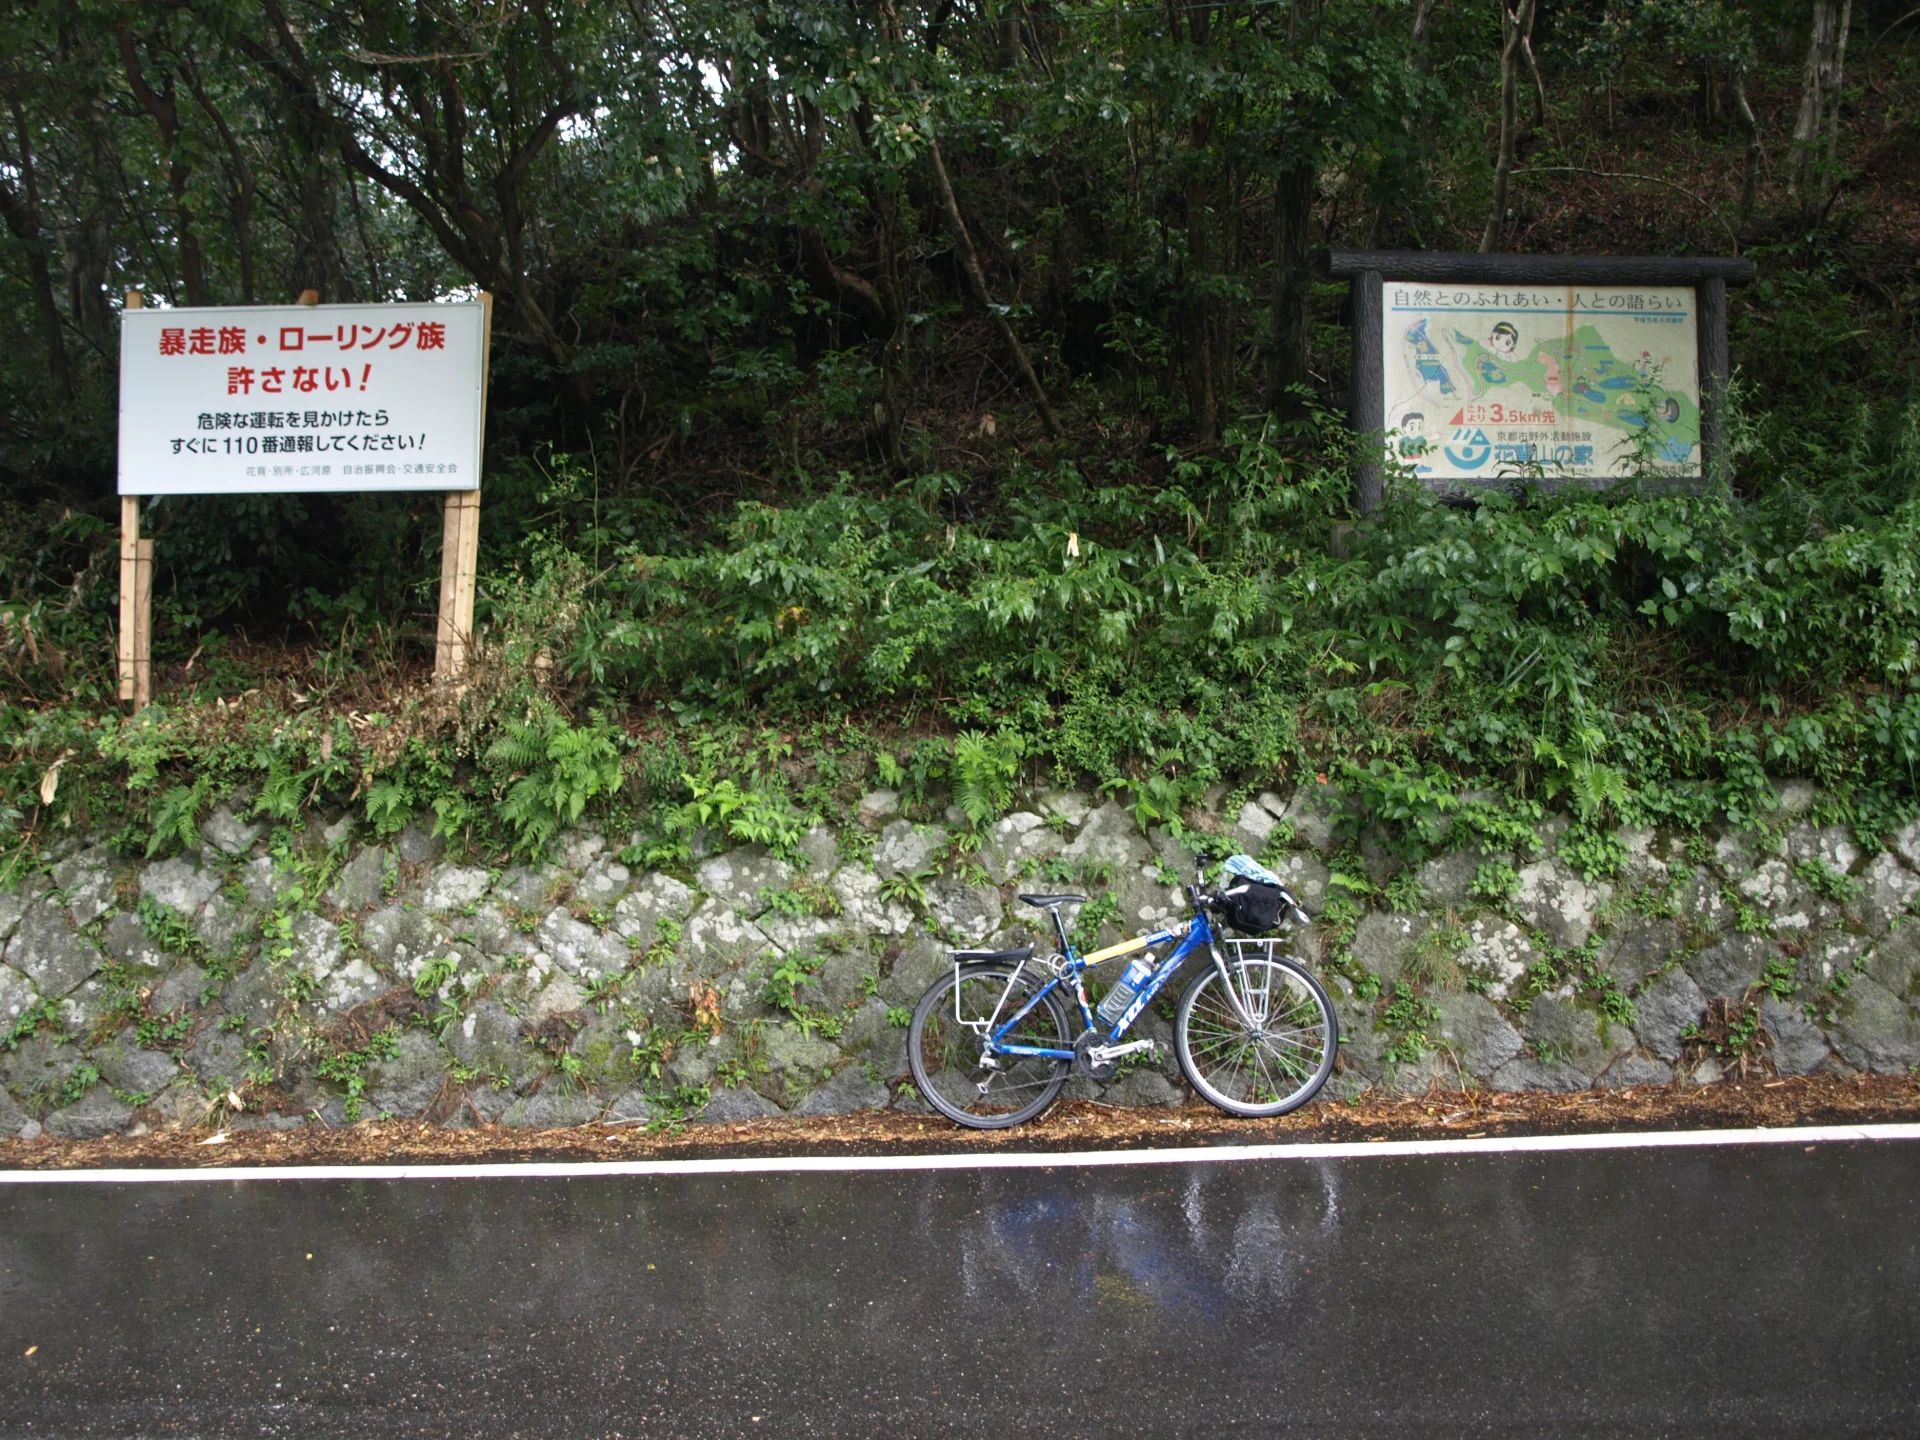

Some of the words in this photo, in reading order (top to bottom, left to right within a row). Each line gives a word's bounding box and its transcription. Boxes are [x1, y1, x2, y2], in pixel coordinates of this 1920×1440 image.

[1393, 288, 1682, 310] 自然とのふれあい・人との語らい
[159, 321, 446, 356] 暴走族・ローリング族
[227, 363, 373, 395] 許さない！
[1467, 404, 1486, 413] これ
[1467, 413, 1486, 423] より
[1489, 402, 1556, 424] 3.5km先
[197, 409, 389, 430] 危険な運転を見かけたら
[170, 433, 426, 455] すぐに110番通報してください！
[1496, 431, 1592, 442] 京都市野外活動施設
[343, 462, 458, 476] 自治振興会・交通安全会
